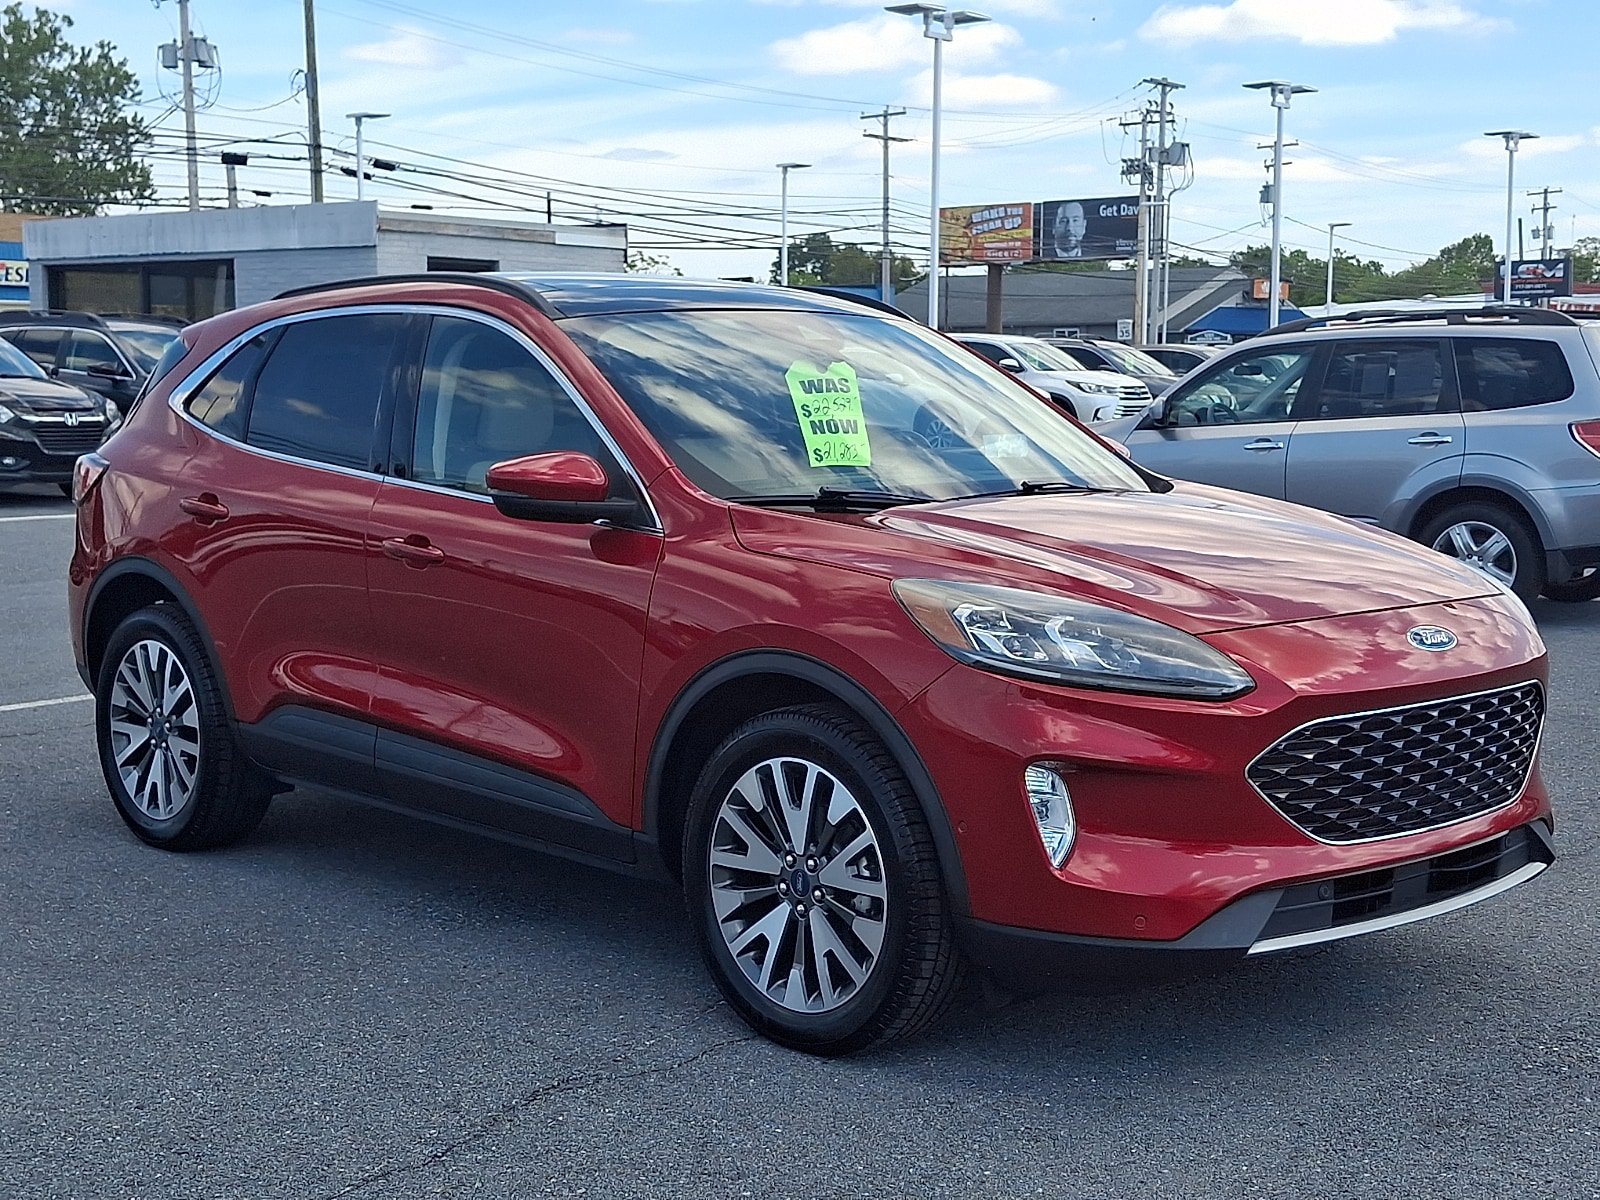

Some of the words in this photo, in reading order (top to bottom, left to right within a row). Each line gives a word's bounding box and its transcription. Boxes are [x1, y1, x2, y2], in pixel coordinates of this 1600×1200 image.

[1099, 204, 1118, 217] Get
[799, 378, 851, 394] WAS
[809, 419, 859, 435] NOW
